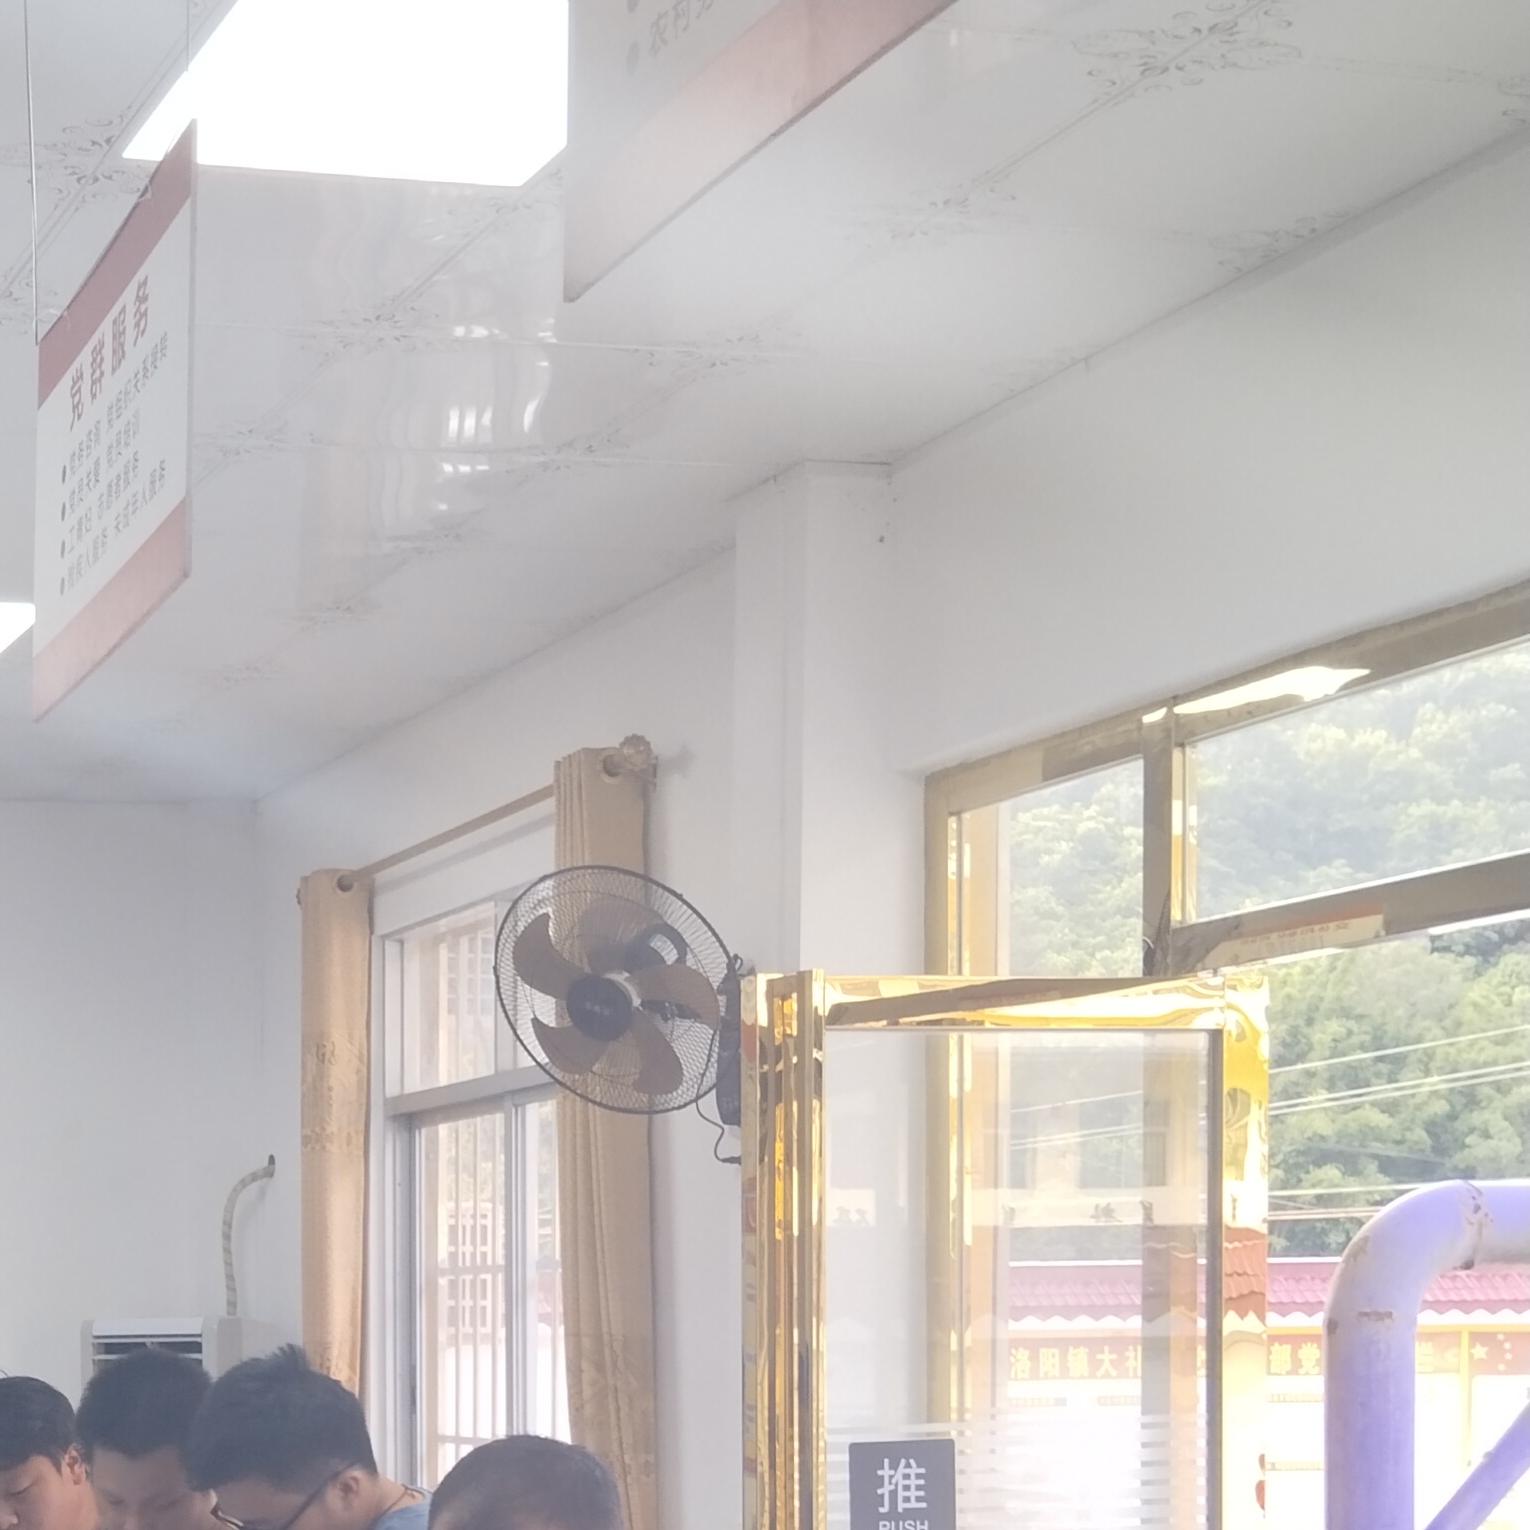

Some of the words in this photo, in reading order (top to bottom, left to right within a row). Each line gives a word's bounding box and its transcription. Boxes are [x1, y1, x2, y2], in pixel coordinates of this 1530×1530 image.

[70, 274, 149, 432] 党群服务
[877, 1457, 927, 1513] 推
